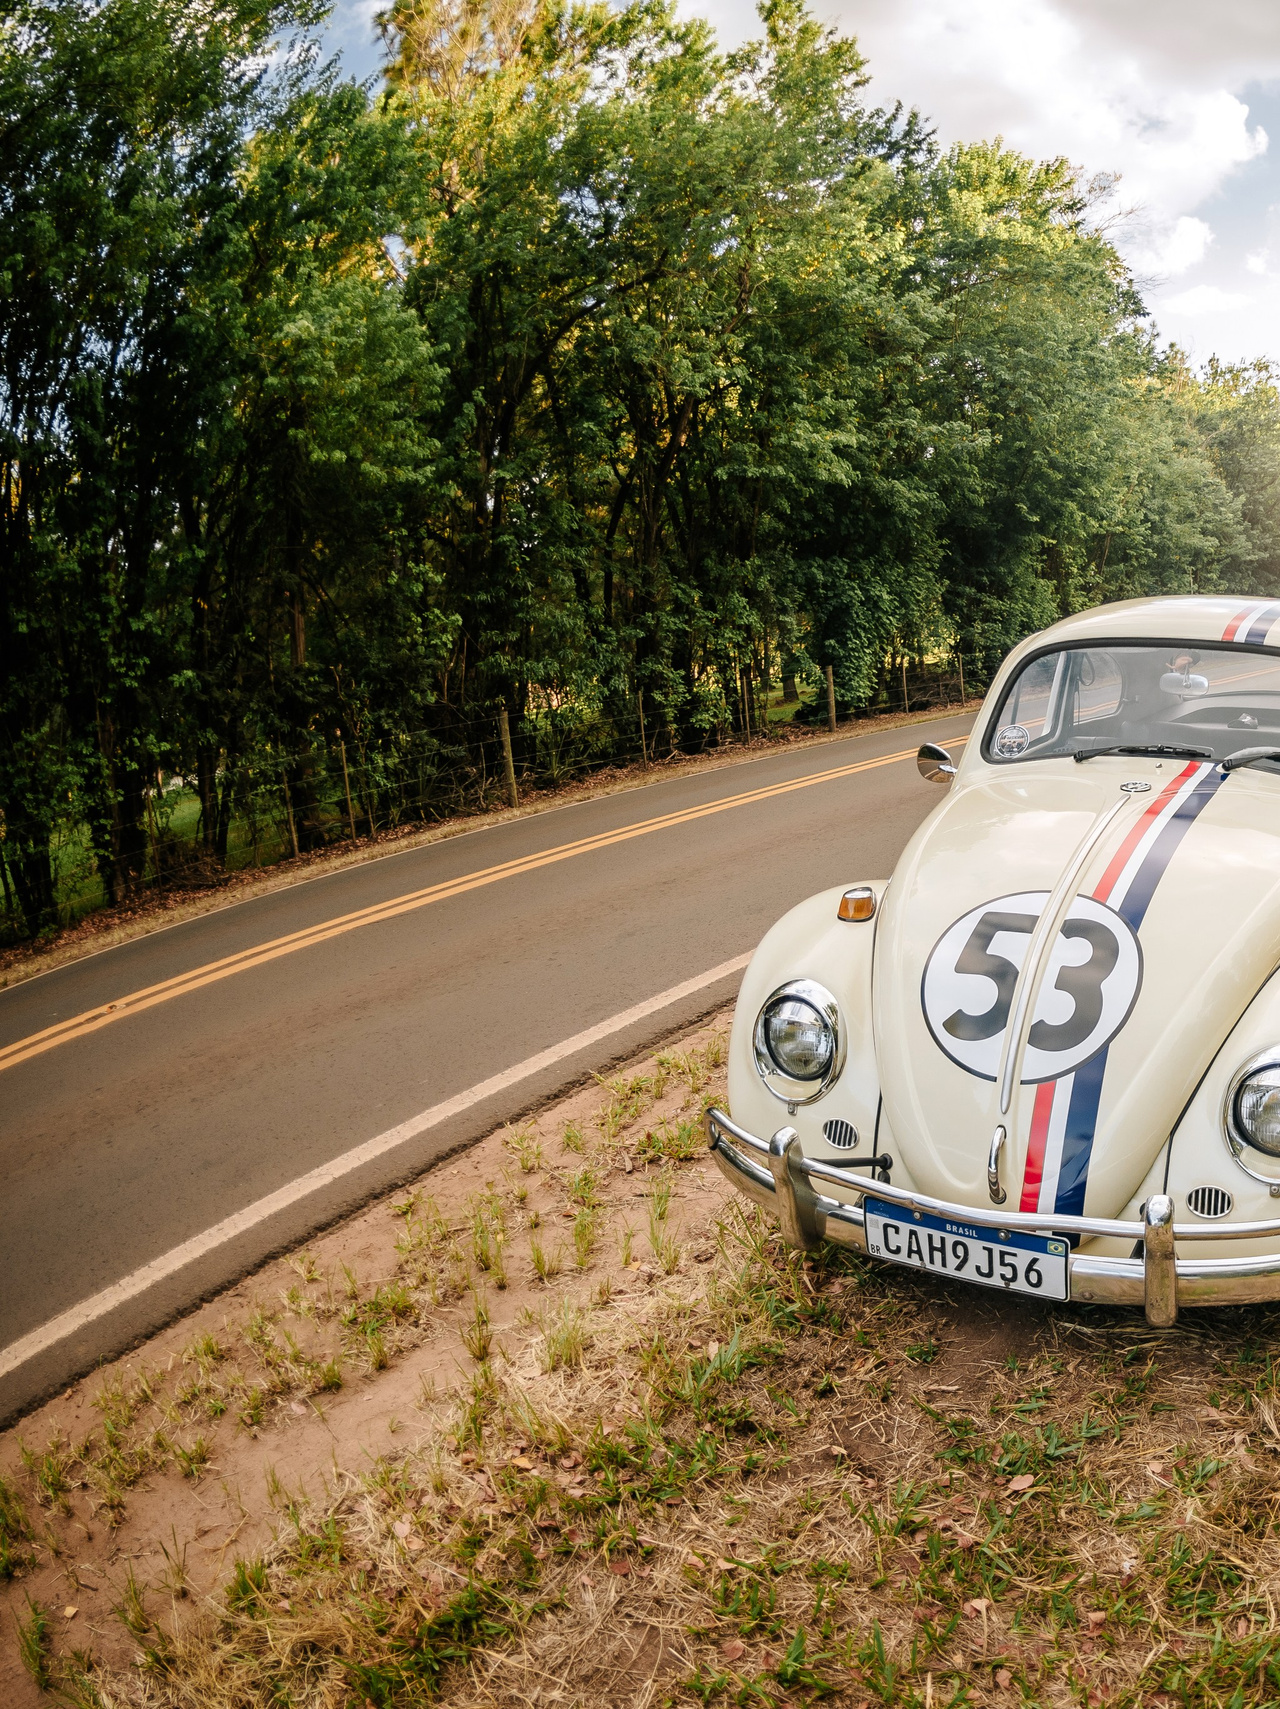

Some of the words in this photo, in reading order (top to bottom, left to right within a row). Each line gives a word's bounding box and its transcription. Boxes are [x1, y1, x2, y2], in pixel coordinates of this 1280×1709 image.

[942, 911, 1120, 1052] 53
[870, 1243, 882, 1256] BR
[946, 1223, 978, 1238] BRASIL
[882, 1222, 1043, 1289] CAH9J56
